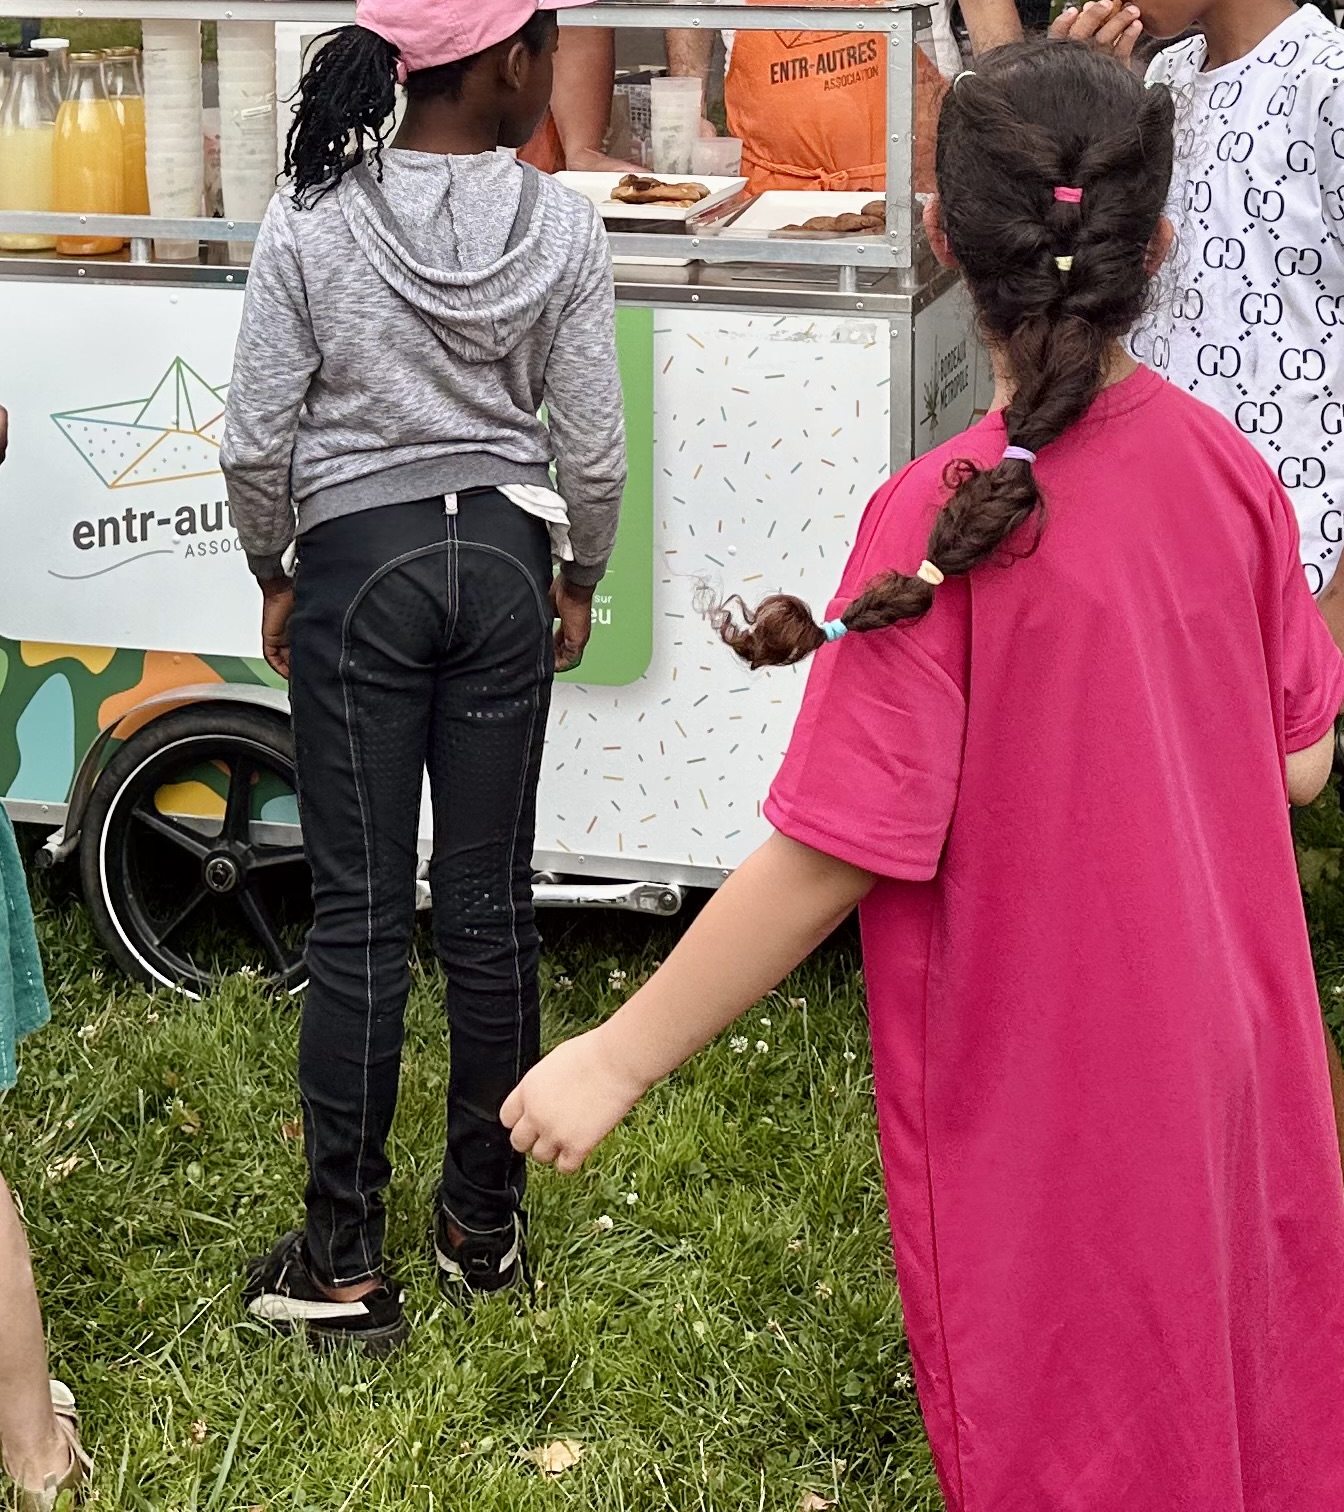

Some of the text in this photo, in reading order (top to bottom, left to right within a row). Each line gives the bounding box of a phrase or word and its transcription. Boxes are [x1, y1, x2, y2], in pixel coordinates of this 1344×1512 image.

[770, 38, 878, 85] ENTR-AUTRES
[823, 64, 879, 91] ASSOCIATION
[594, 593, 613, 604] sur
